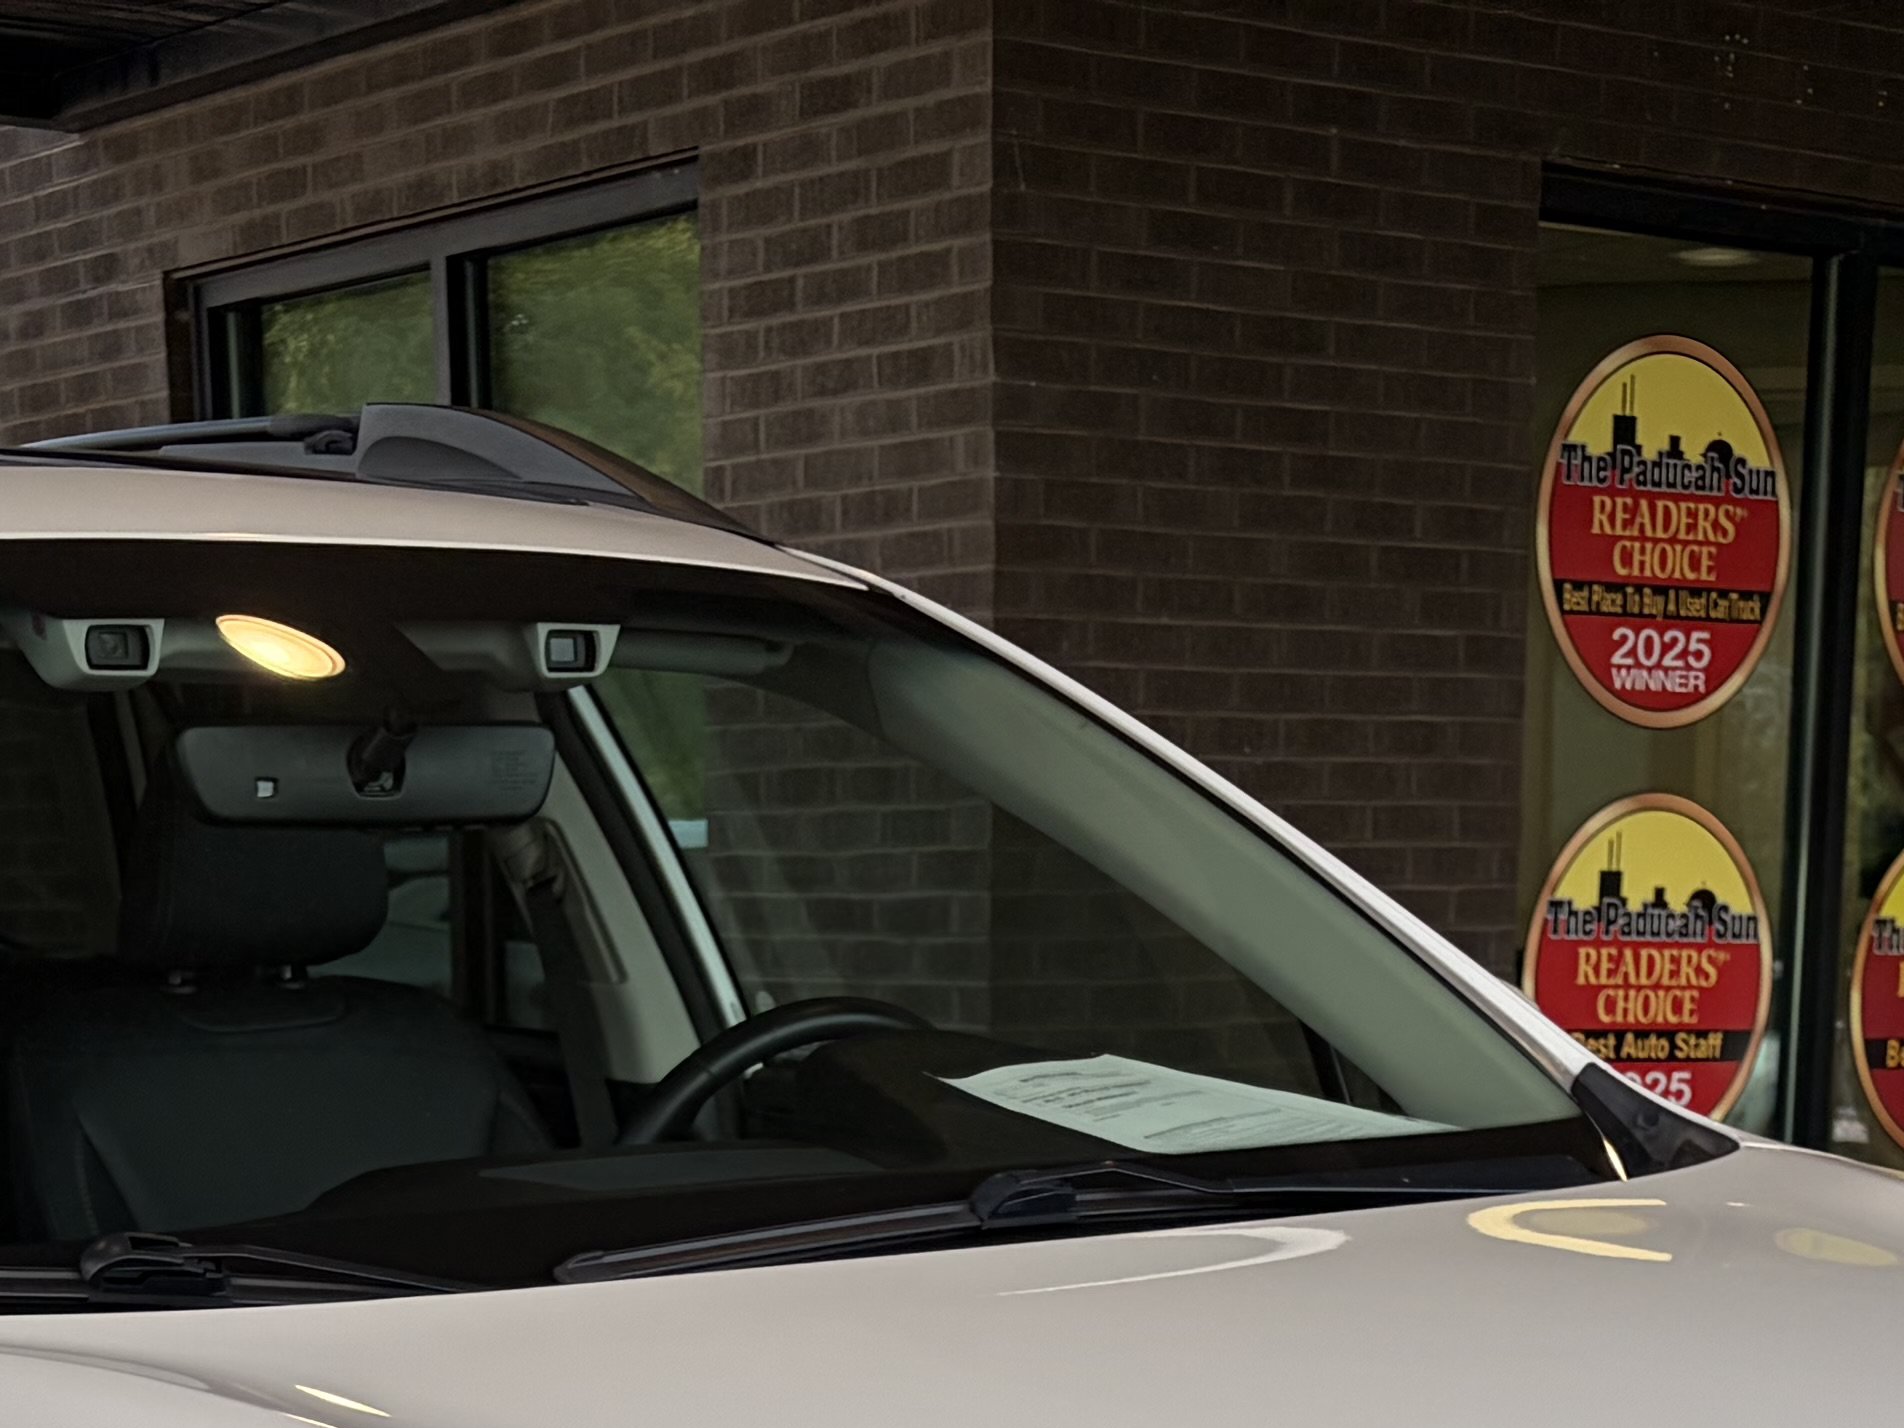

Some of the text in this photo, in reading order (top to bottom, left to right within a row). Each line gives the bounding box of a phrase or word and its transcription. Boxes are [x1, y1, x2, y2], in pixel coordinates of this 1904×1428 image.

[1560, 442, 1779, 500] The Paducah Sun
[1613, 541, 1717, 582] CHOICE
[1611, 627, 1712, 669] 2025
[1611, 667, 1707, 694] WINNER
[1546, 896, 1760, 944] The Paducah Sun
[1597, 988, 1701, 1025] CHOICE
[1620, 1032, 1670, 1060] Auto
[1674, 1033, 1725, 1060] Staff
